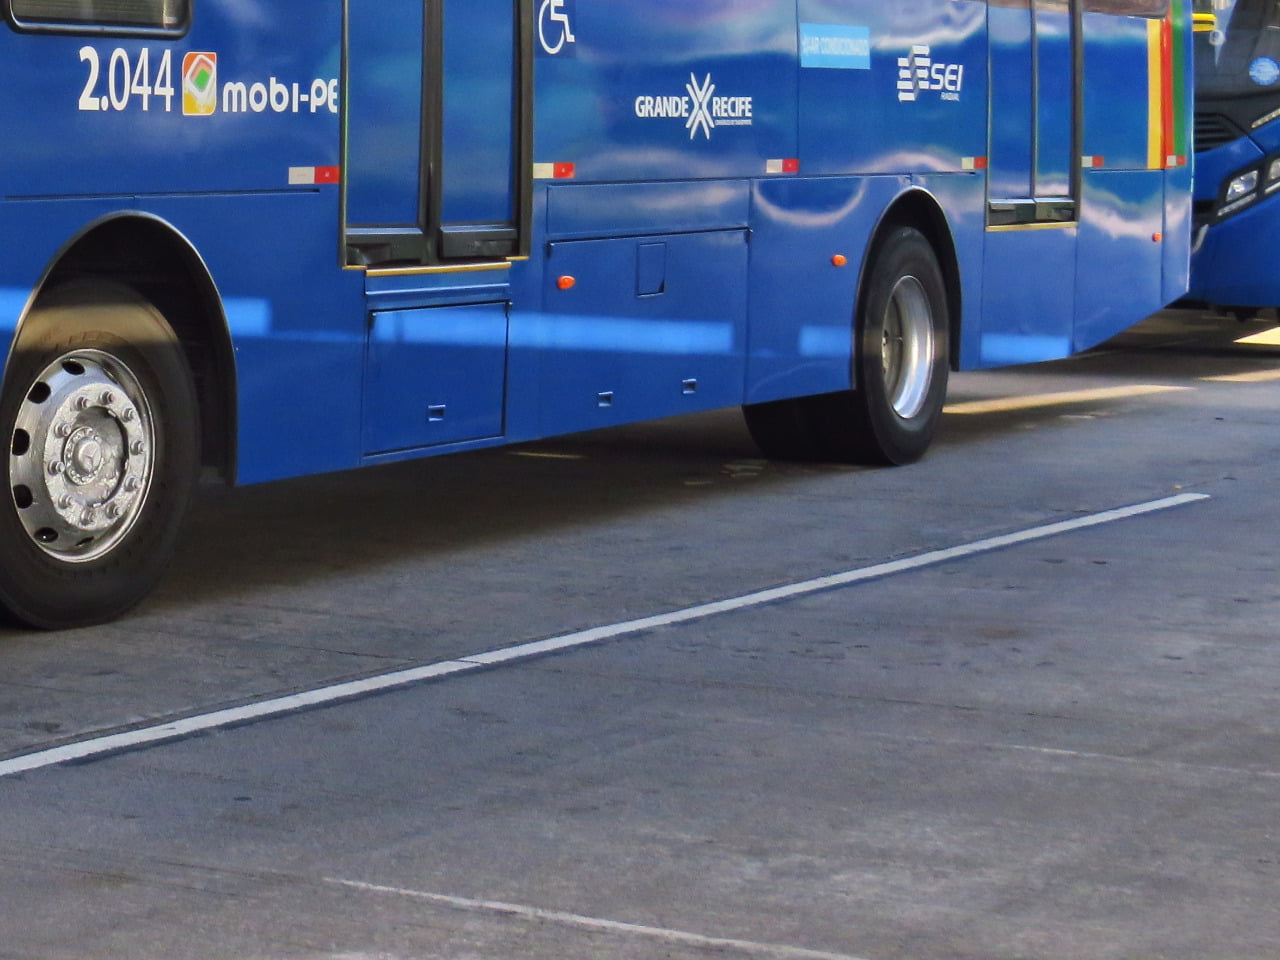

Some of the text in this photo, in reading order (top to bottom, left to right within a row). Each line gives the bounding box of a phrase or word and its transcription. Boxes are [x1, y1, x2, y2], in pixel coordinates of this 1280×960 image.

[79, 45, 174, 112] 2.044
[929, 63, 963, 92] SEI
[635, 96, 752, 118] GRANDE RECIFE
